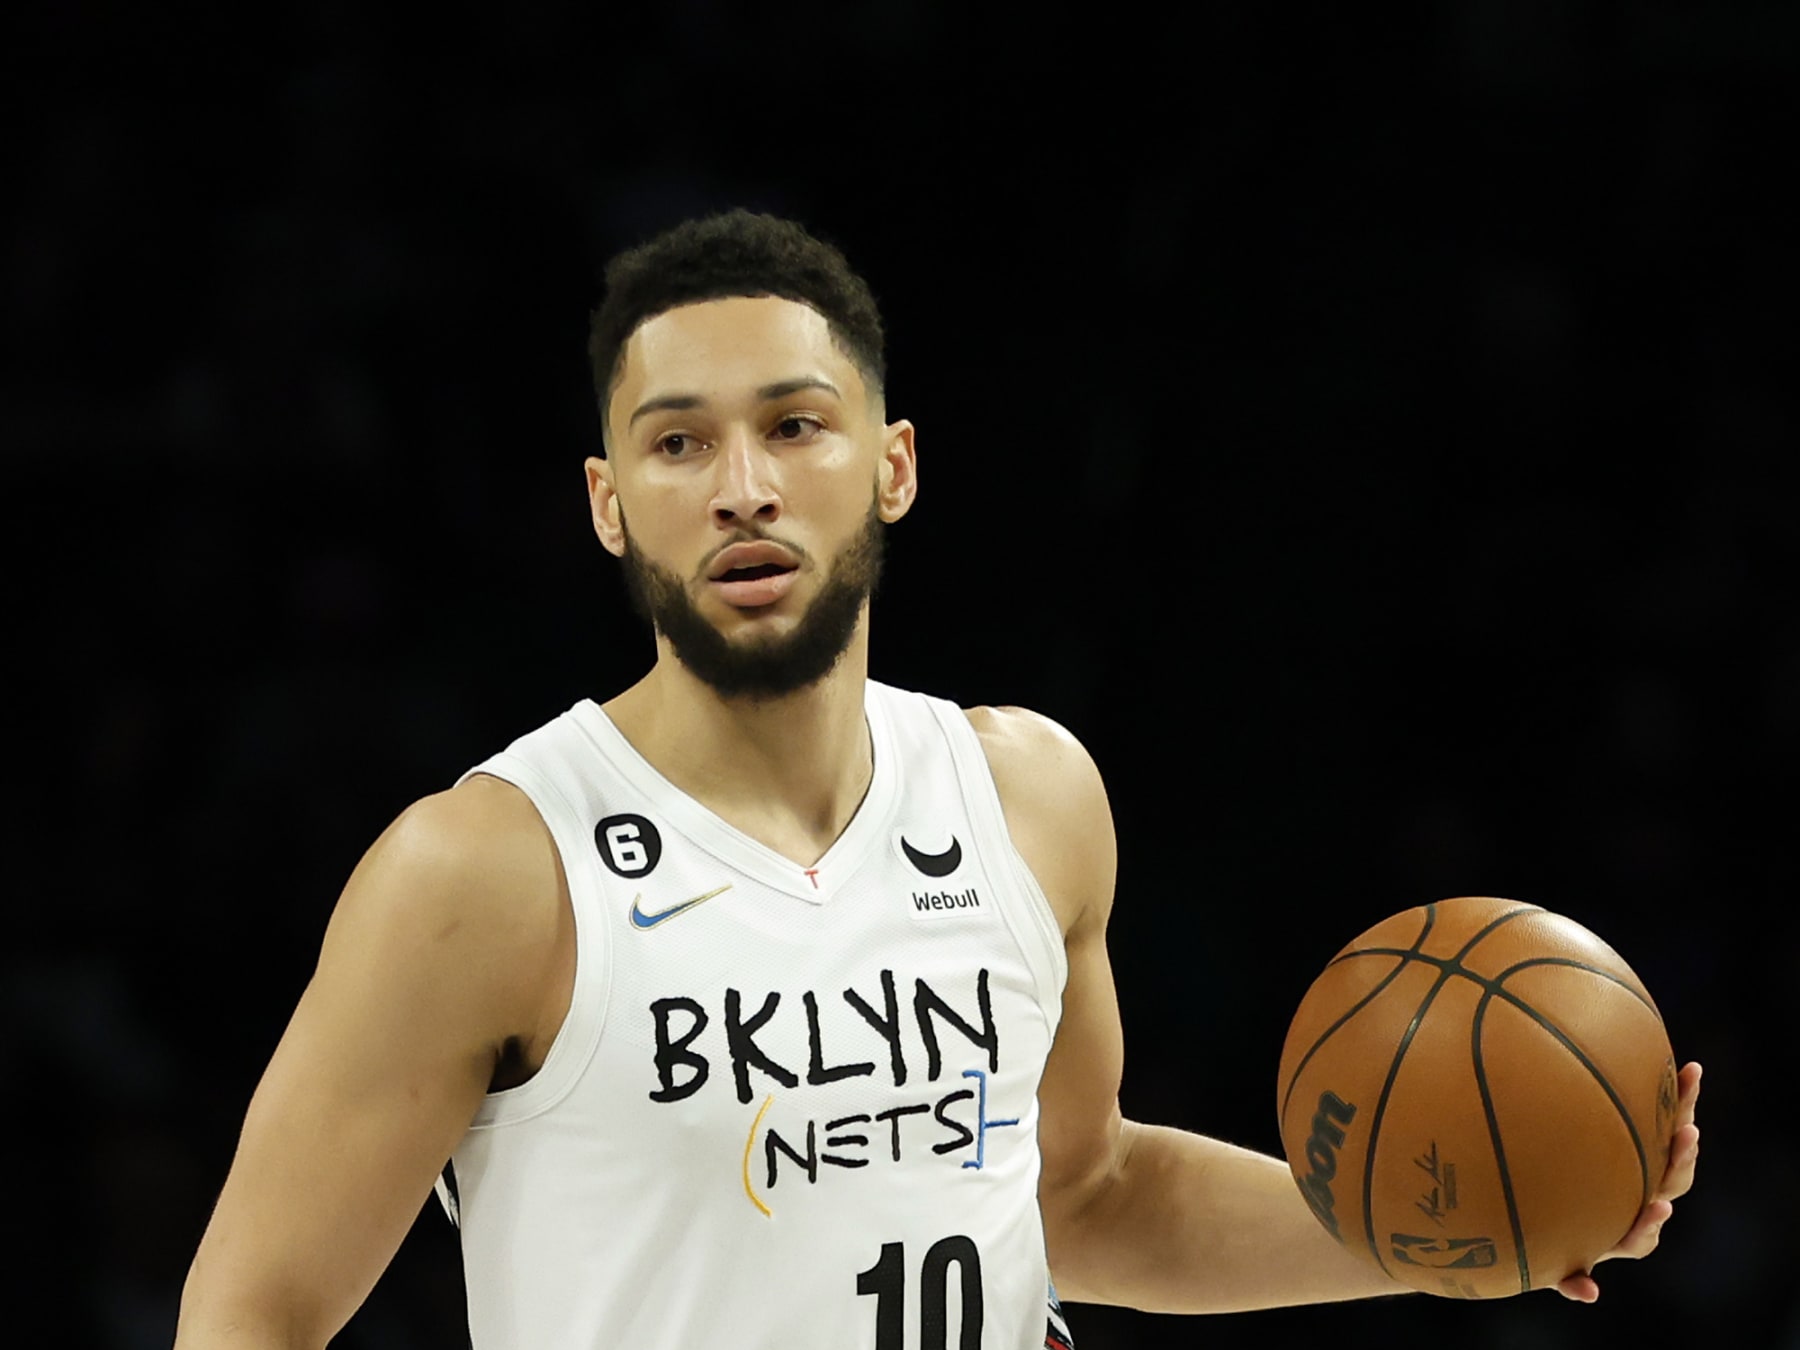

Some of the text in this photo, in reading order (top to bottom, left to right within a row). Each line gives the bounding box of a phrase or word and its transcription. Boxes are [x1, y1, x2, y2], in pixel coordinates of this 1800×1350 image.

[605, 822, 649, 871] 6
[912, 888, 981, 912] Webull
[648, 967, 999, 1105] BKLYN
